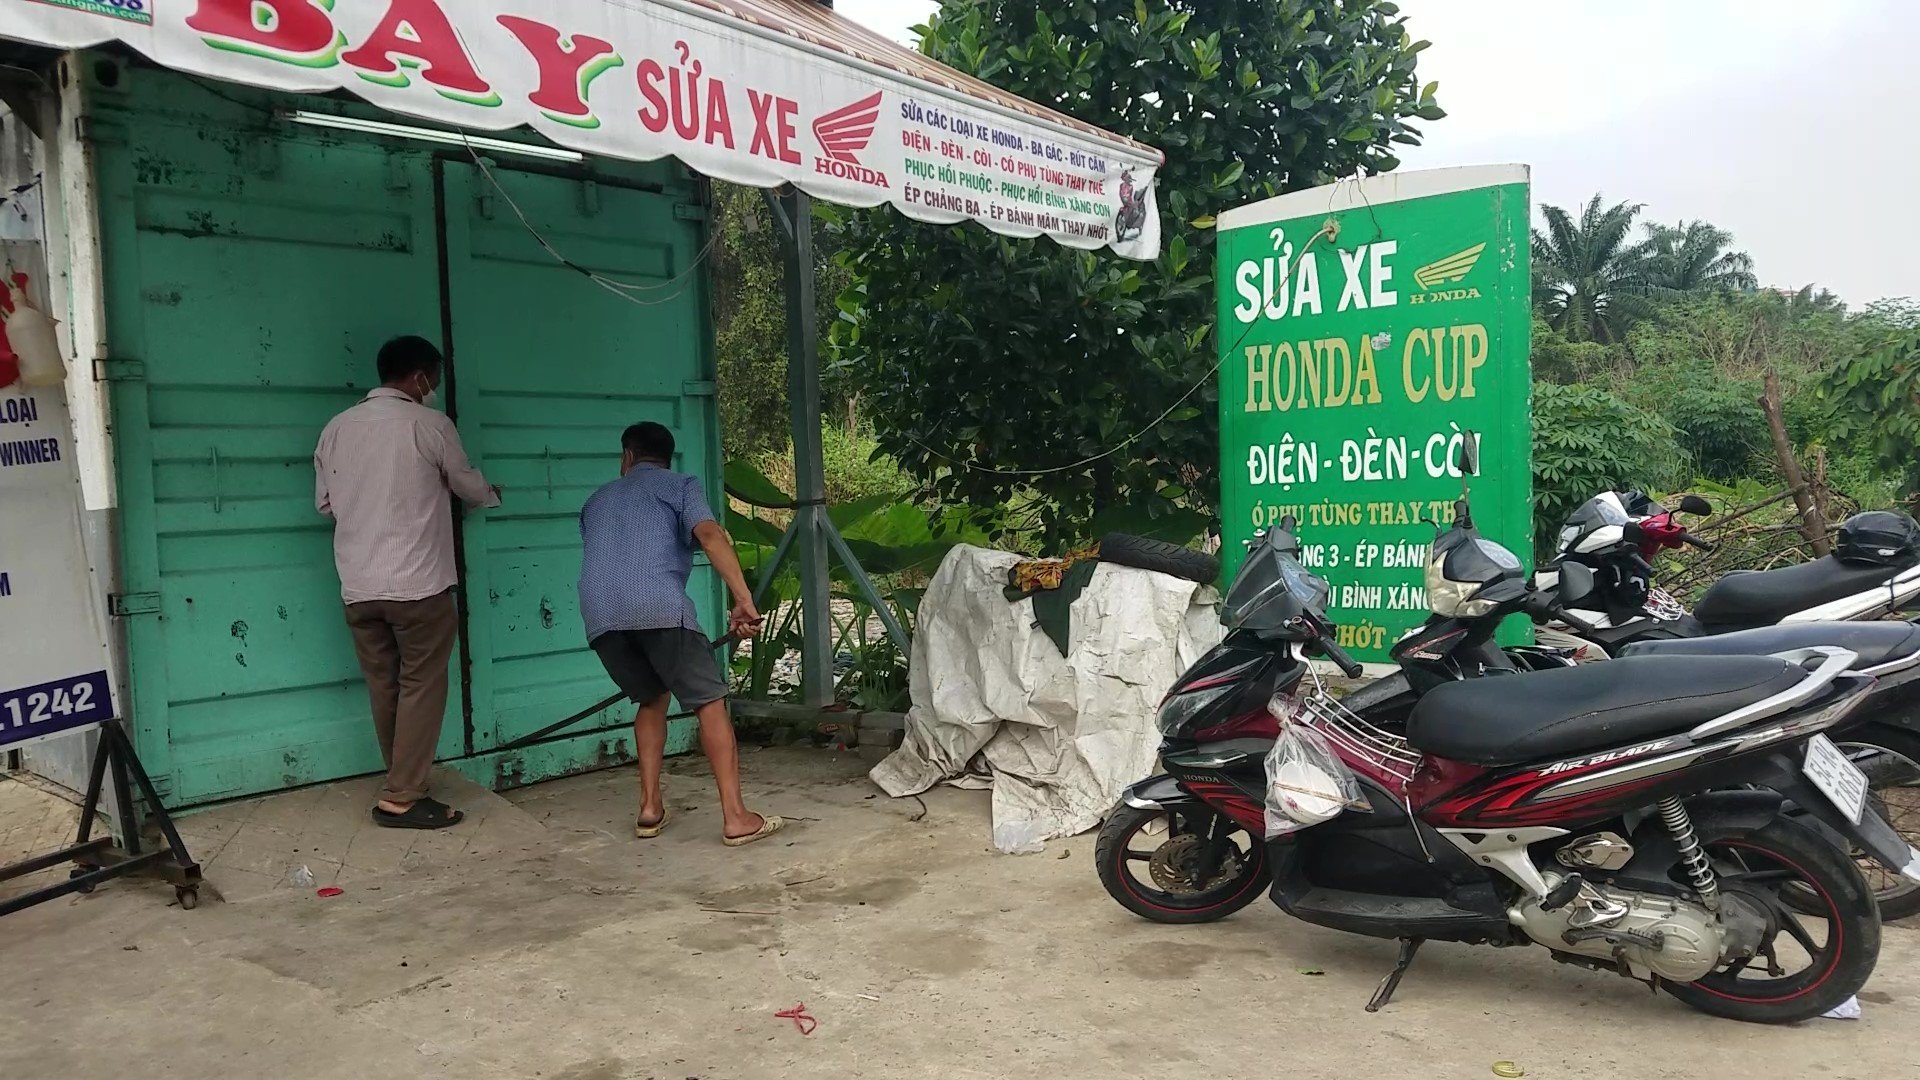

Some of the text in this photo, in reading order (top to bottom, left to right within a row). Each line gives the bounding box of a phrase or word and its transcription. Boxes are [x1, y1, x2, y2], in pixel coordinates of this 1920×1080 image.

[636, 40, 736, 150] SỬA
[747, 88, 802, 166] XE
[901, 99, 924, 124] SỬA
[927, 108, 948, 130] CÁC
[951, 117, 974, 140] LOẠI
[976, 124, 989, 142] XE
[992, 129, 1023, 151] HONDA
[1031, 140, 1044, 157] BA
[1045, 143, 1063, 162] GÁC
[1070, 150, 1086, 169] RÚT
[814, 156, 891, 189] HONDA
[902, 129, 931, 153] ĐIỆN
[941, 138, 964, 161] ĐÈN
[973, 147, 992, 168] CÒI
[1001, 155, 1015, 173] CÓ
[1018, 161, 1037, 182] PHỤ
[1040, 165, 1064, 186] TÙNG
[1066, 174, 1087, 192] THAY
[1089, 178, 1106, 196] THẾ
[904, 158, 935, 181] PHỤC
[938, 161, 957, 185] HỒI
[959, 171, 993, 194] PHUỘC
[1001, 181, 1026, 203] PHỤC
[1028, 183, 1043, 206] HỒI
[1046, 189, 1067, 210] BÌNH
[1093, 202, 1111, 218] CON
[904, 181, 921, 204] ÉP
[924, 188, 963, 213] CHẢNG
[965, 198, 981, 217] BA
[990, 200, 1004, 221] ÉP
[1006, 206, 1035, 227] BÁNH
[1062, 219, 1086, 236] THAY
[1087, 222, 1110, 241] NHỚT
[1233, 227, 1398, 323] SỬA XE
[1244, 323, 1489, 413] HONDA CUP
[0, 397, 38, 428] LOẠI
[0, 437, 61, 467] WINNER
[1246, 431, 1318, 492] ĐIỆN
[1339, 426, 1407, 482] ĐÈN
[1308, 497, 1363, 526] TÙNG
[1366, 501, 1424, 526] THAY
[1328, 544, 1340, 568] 3
[1354, 538, 1379, 568] ÉP
[1341, 580, 1382, 609] BÌNH
[1336, 618, 1387, 649] HỚT
[1588, 739, 1675, 766] BLADE
[1183, 774, 1221, 784] HONDA
